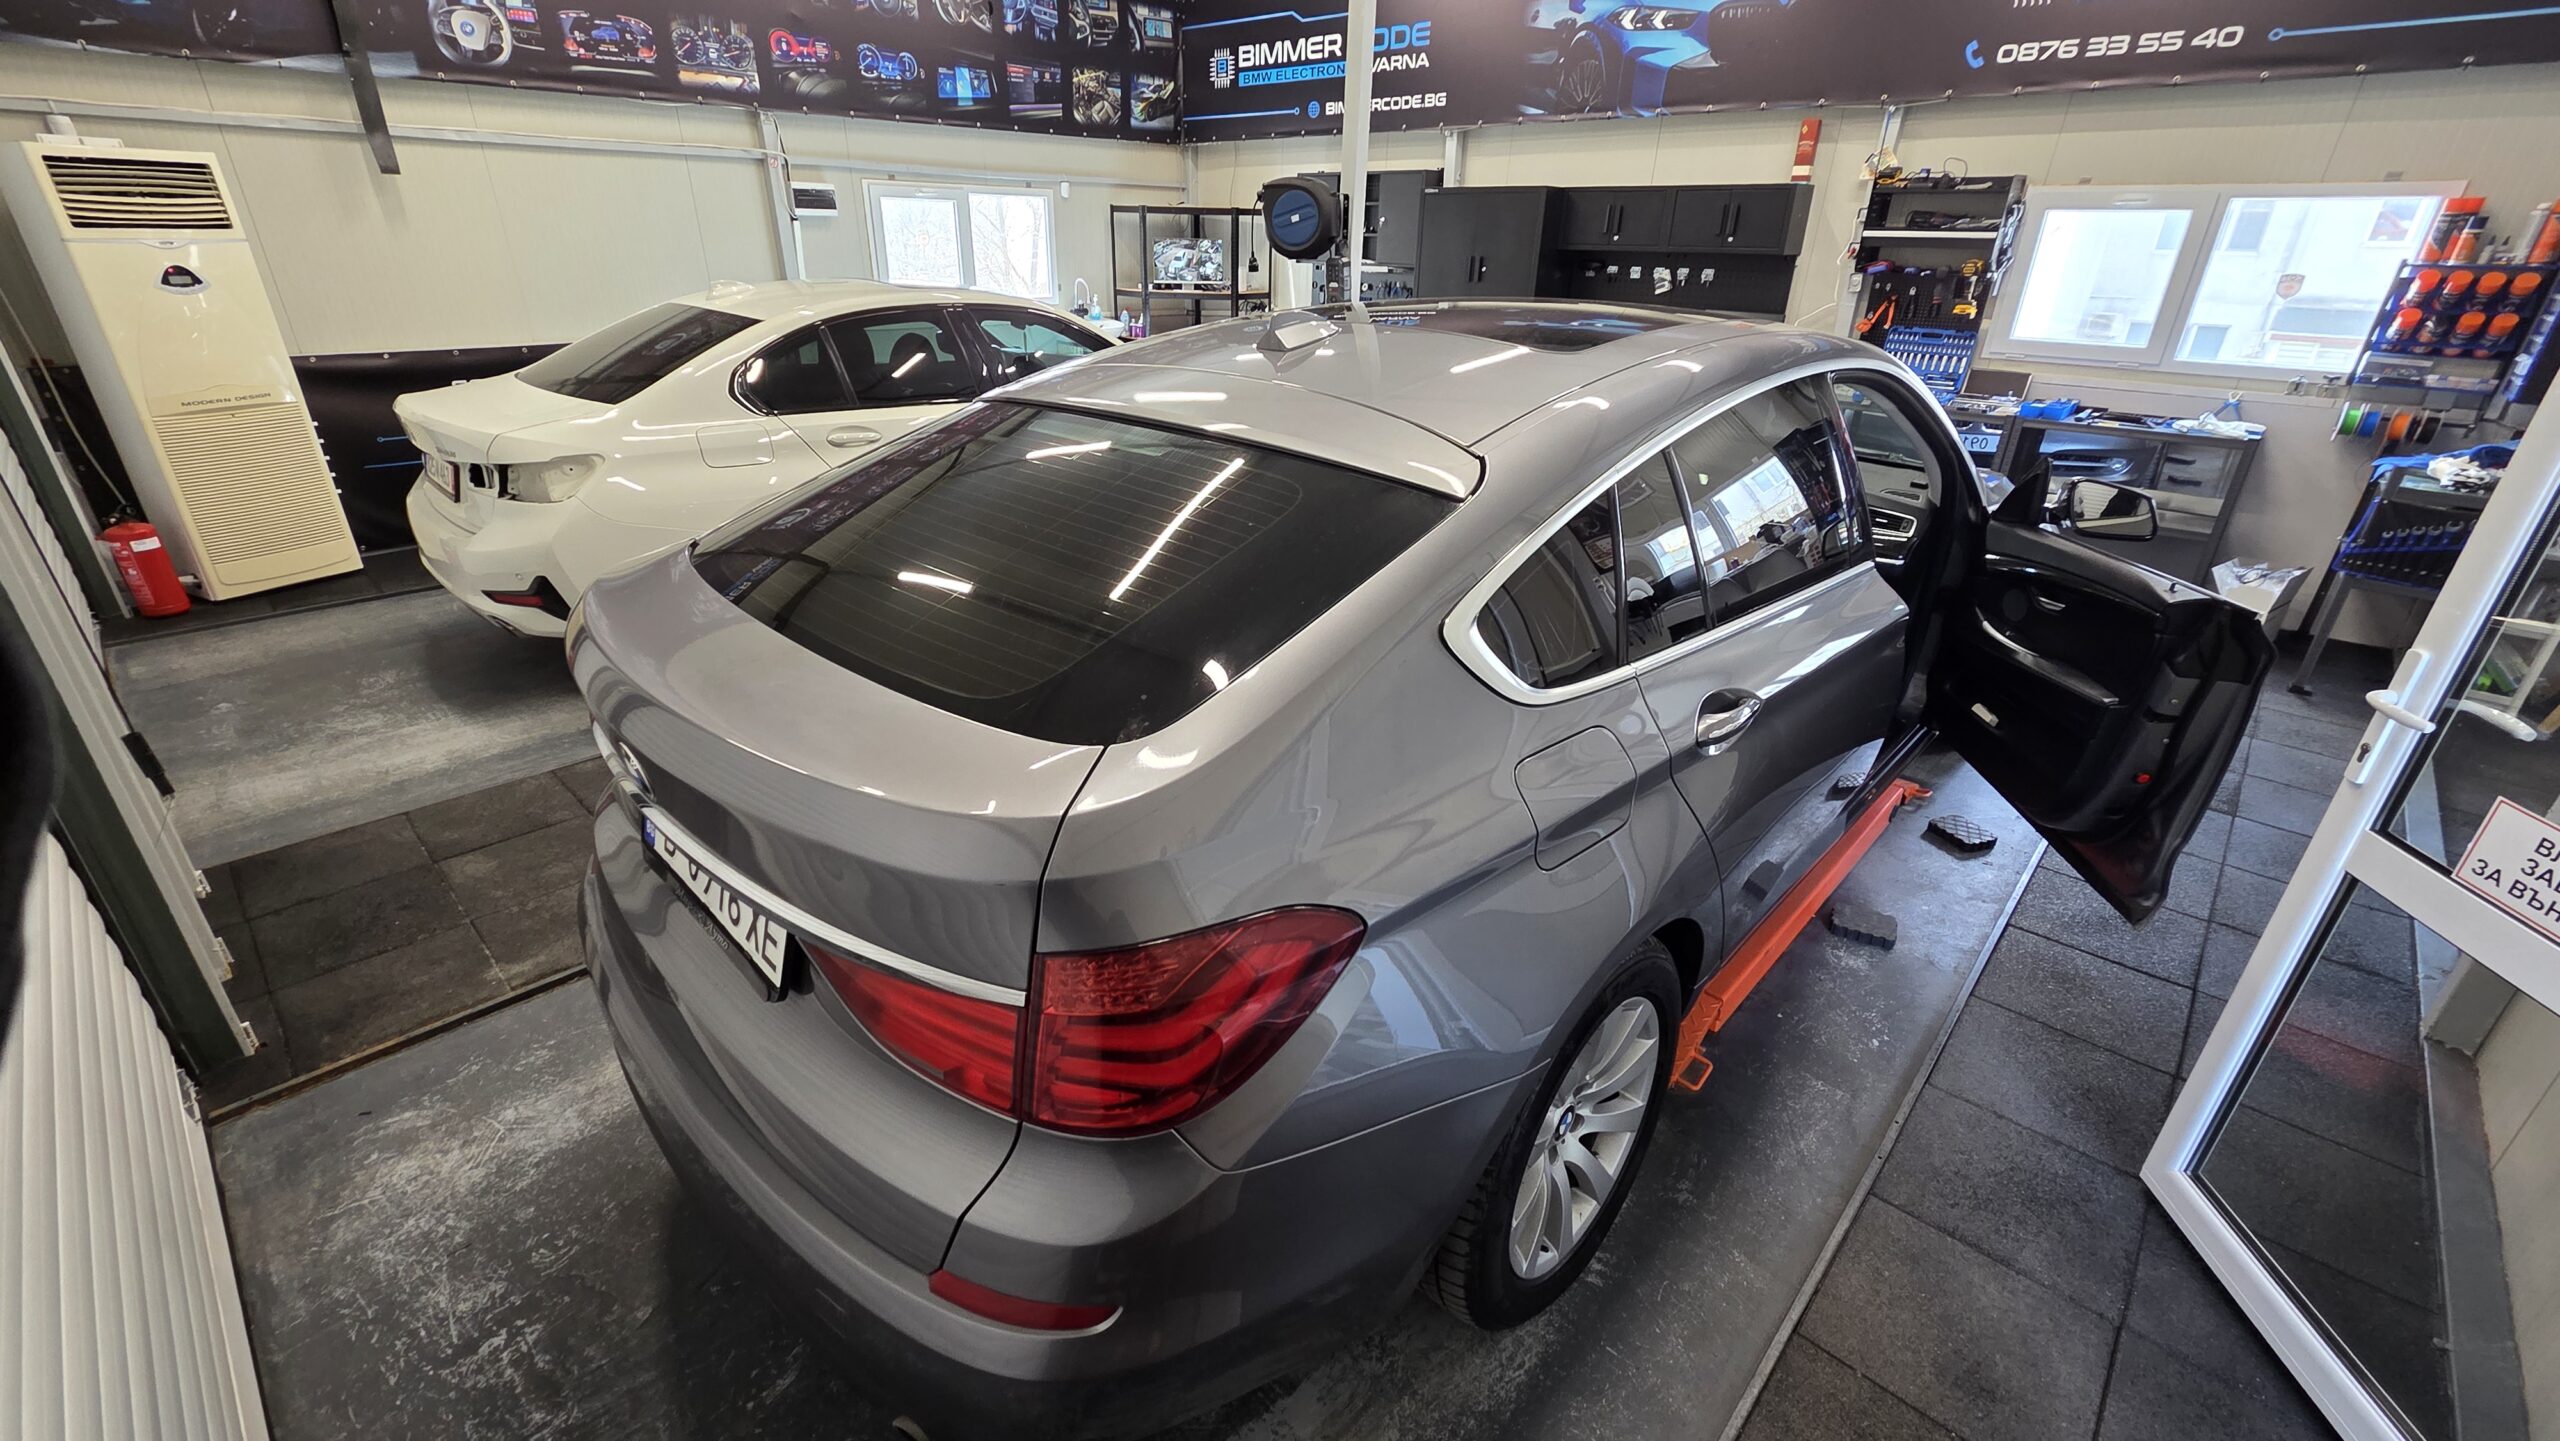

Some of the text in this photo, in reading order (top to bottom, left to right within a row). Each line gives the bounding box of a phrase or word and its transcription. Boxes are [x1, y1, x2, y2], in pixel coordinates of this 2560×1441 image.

[1997, 25, 2245, 64] 0876 33 55 40
[1243, 63, 1346, 84] BMW ELECTRON
[181, 392, 271, 407] MODERN DESIGN
[2471, 858, 2502, 888] ЗА
